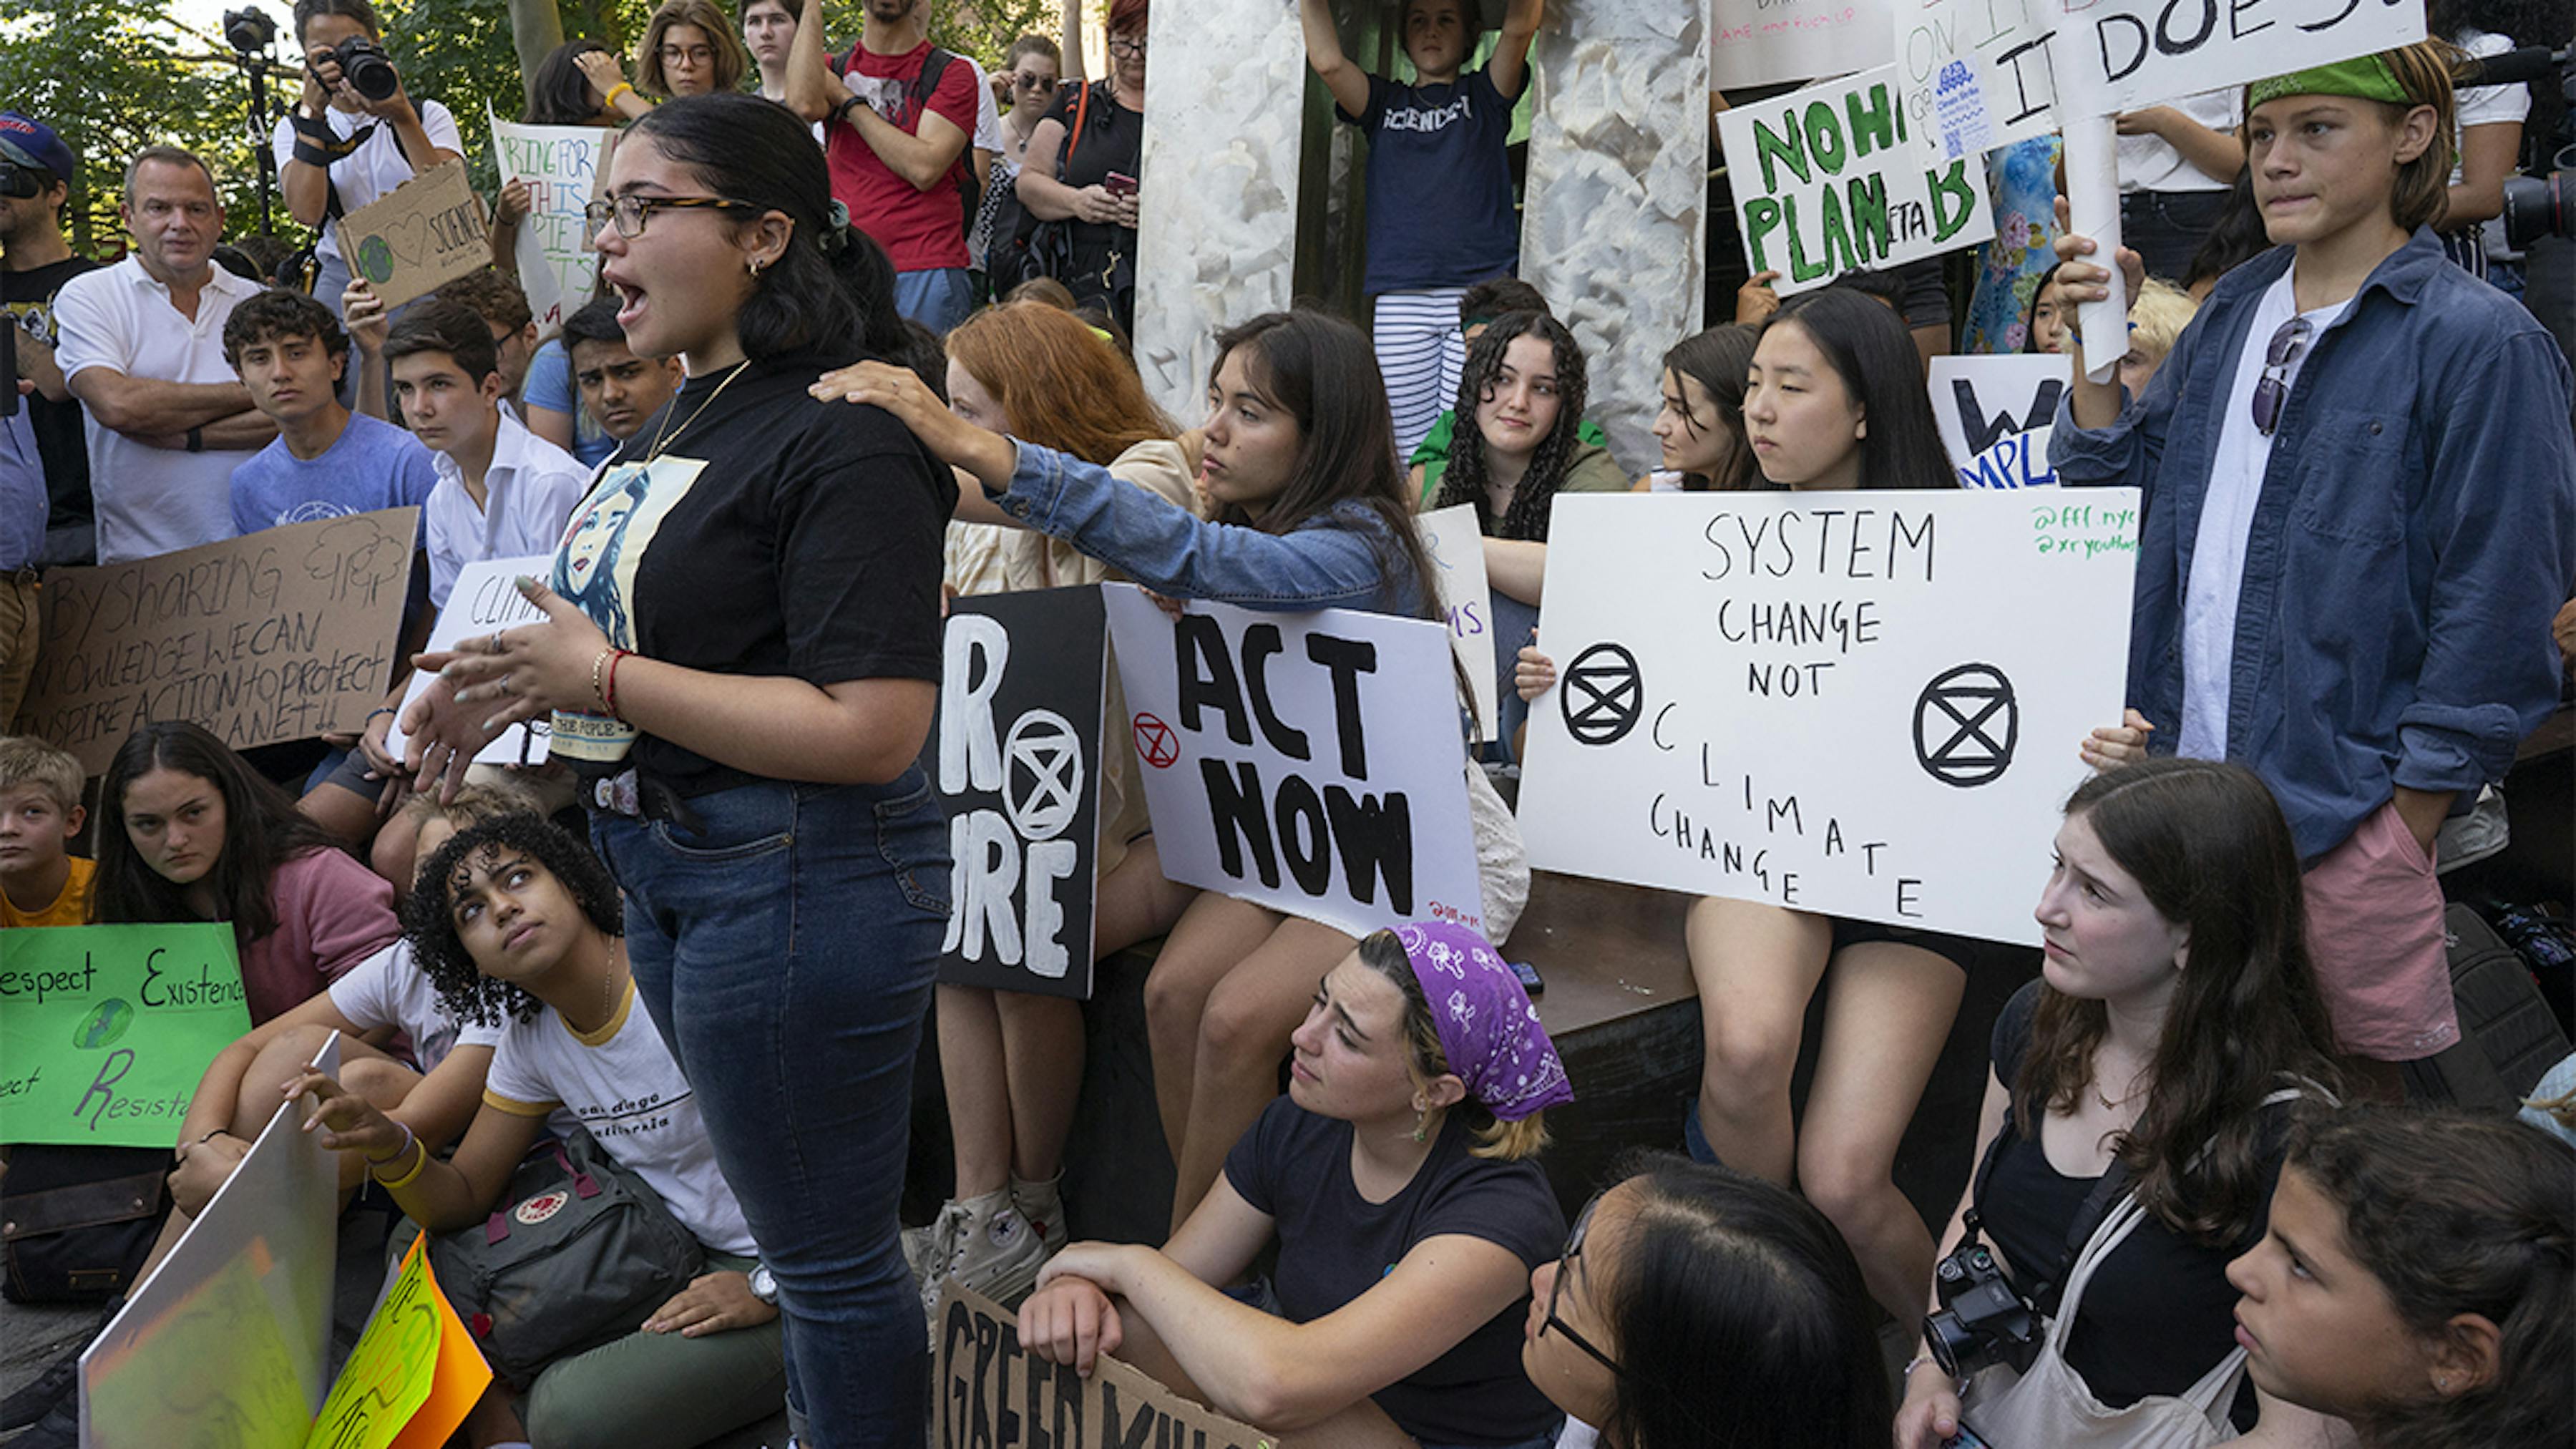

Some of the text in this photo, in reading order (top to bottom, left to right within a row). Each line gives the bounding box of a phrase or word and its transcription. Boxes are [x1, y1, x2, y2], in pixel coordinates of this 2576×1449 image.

[557, 139, 596, 180] FOR
[429, 200, 489, 254] SCIENCE
[1702, 509, 1934, 582] SYSTEM
[250, 612, 322, 655] CAN
[1718, 599, 1881, 653] CHANGE
[1174, 613, 1377, 781] ACT
[1749, 663, 1835, 696] NOT
[1652, 701, 1923, 918] CLIMATE
[1199, 757, 1414, 917] NOW
[1650, 793, 1801, 904] CHANGE
[0, 950, 97, 1005] espect
[593, 1116, 669, 1138] alifornia
